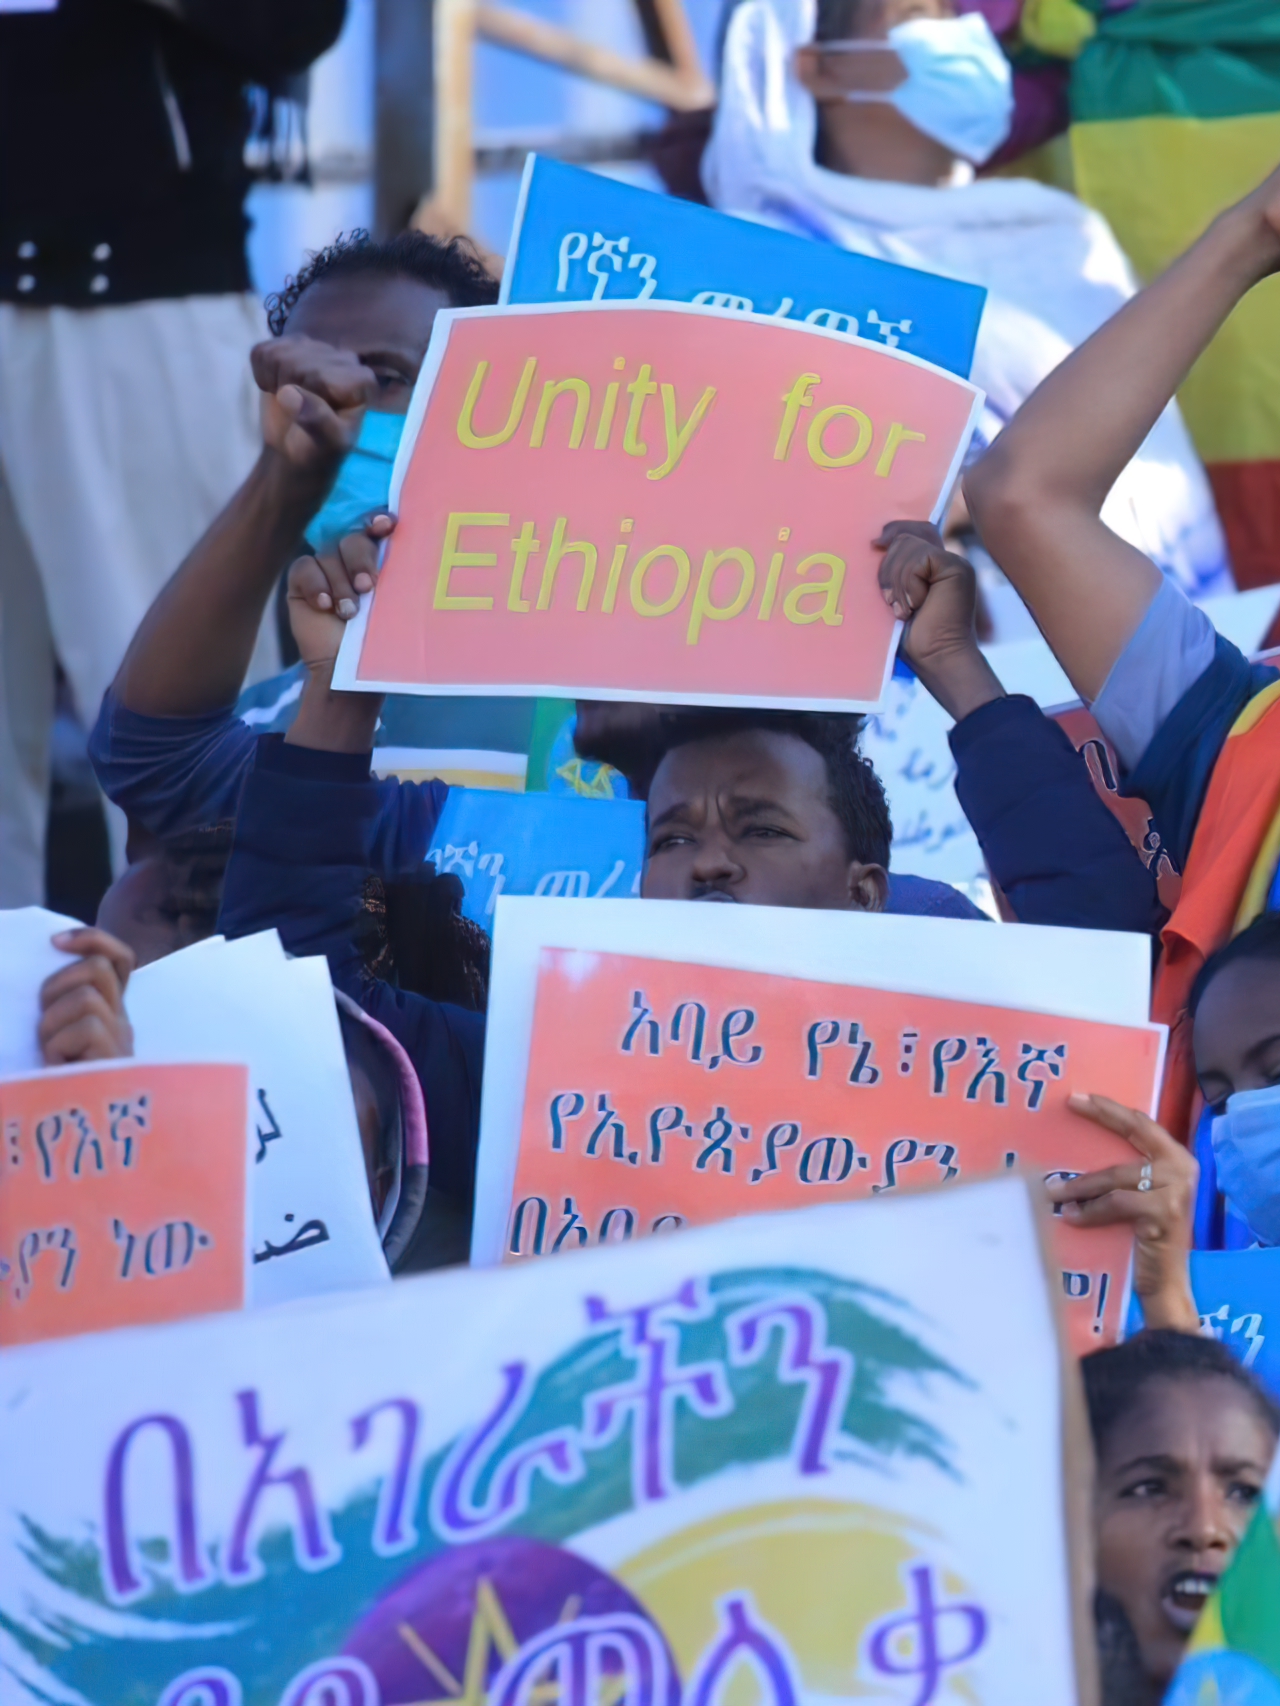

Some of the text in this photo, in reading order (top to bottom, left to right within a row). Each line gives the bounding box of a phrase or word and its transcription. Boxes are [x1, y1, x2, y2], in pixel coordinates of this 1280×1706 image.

[455, 357, 926, 480] Unity for
[432, 512, 847, 646] Ethiopia
[620, 989, 763, 1070] አባይ
[0, 1228, 77, 1301] ያን
[112, 1218, 210, 1278] ነው
[104, 1276, 845, 1598] በአገራችን
